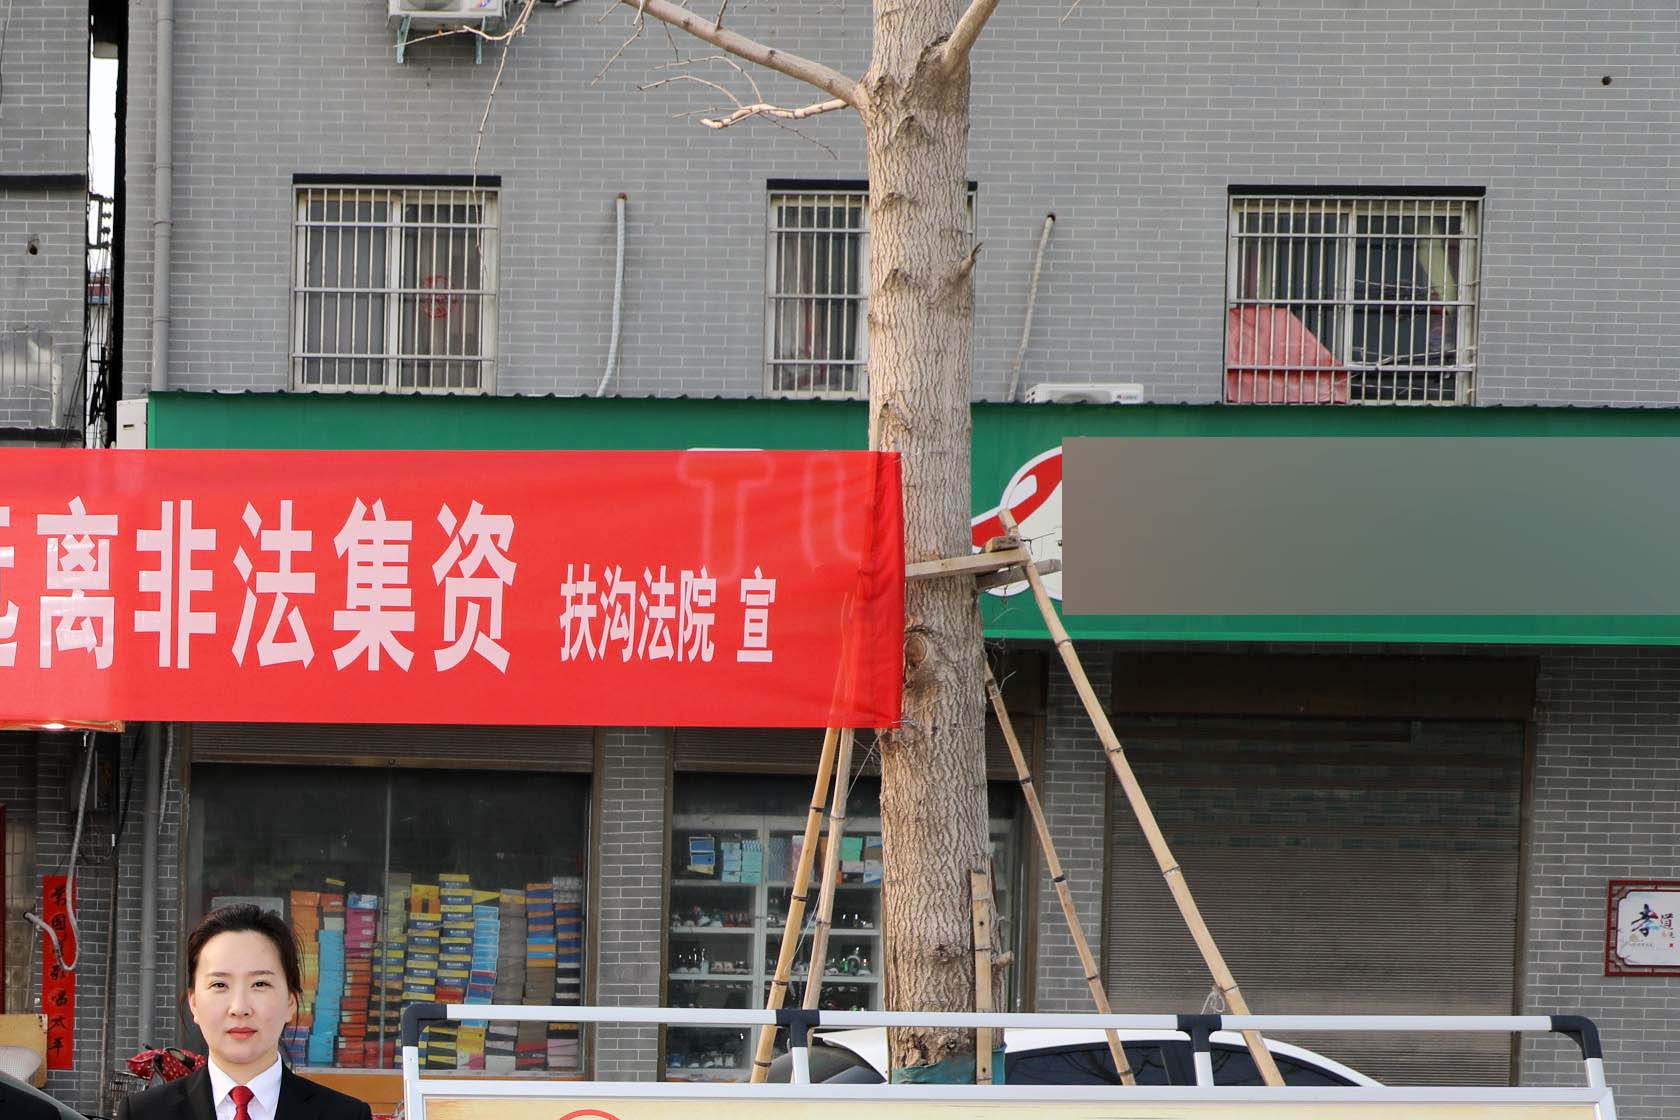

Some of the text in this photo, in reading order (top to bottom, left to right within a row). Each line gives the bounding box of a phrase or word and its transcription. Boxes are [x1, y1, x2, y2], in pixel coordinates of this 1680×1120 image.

[559, 564, 715, 663] 扶沟法院
[736, 565, 778, 663] 宣
